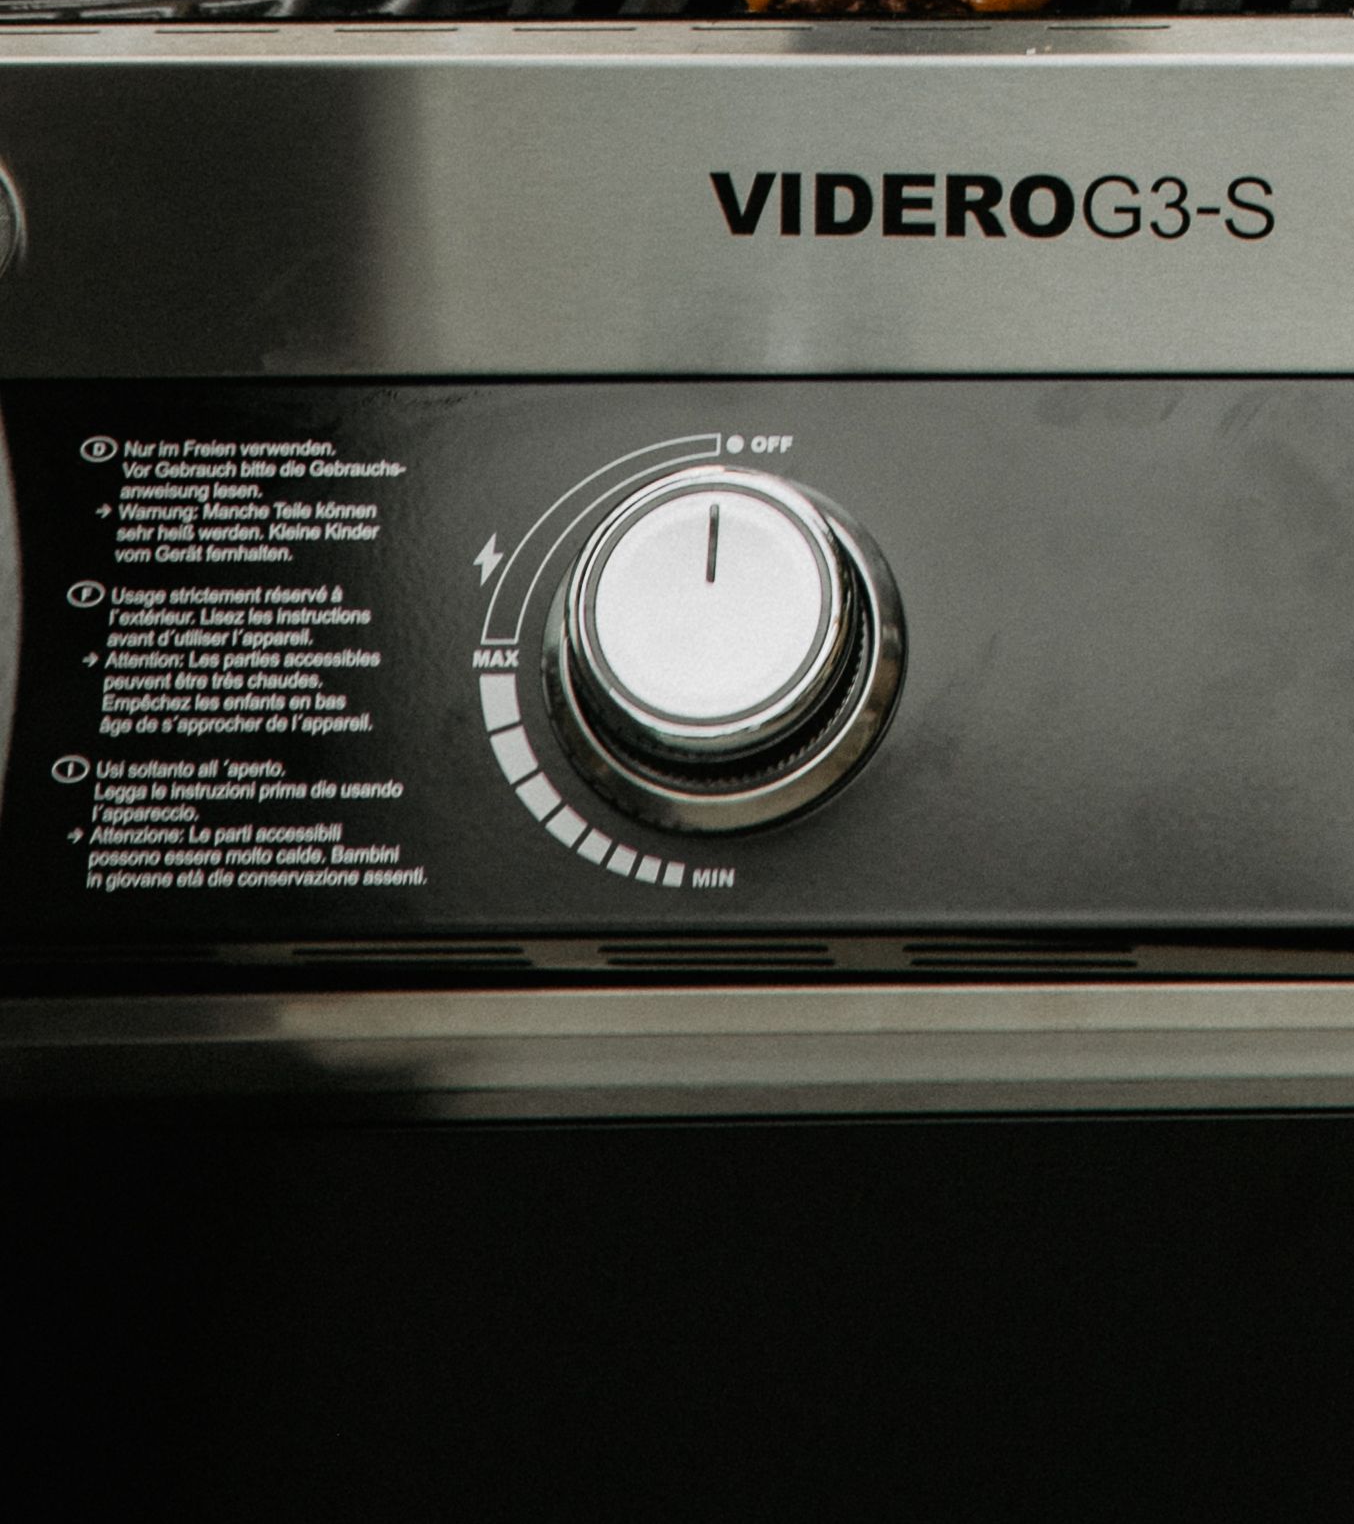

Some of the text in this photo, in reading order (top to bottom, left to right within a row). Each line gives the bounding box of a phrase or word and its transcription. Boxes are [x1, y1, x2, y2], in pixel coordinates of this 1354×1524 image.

[124, 441, 155, 457] Nur
[158, 441, 179, 457] im
[184, 440, 236, 457] Freien
[241, 439, 336, 456] verwenden.
[750, 435, 794, 454] OFF
[123, 462, 151, 478] Vor
[155, 461, 236, 478] Gebrauch
[241, 461, 275, 477] bitte
[309, 459, 406, 477] Gebrauchs-
[120, 482, 263, 502] anweisung lesen.
[203, 502, 269, 519] Manche
[274, 502, 311, 519] Teile
[315, 502, 377, 519] können
[116, 523, 380, 541] sehr heiß werden. Kleine Kinder
[114, 548, 150, 562] vom
[155, 545, 203, 562] Gerät
[112, 587, 166, 608] Usage
[169, 587, 261, 604] strictement
[200, 608, 244, 625] Lisez
[248, 608, 273, 625] les
[277, 606, 371, 624] instructions
[106, 630, 154, 647] avant
[104, 649, 380, 671] Attention: Les parties accessibles
[473, 649, 519, 668] MAX
[103, 673, 171, 693] peuvent
[195, 694, 219, 711] les
[223, 693, 286, 711] enfants
[289, 696, 311, 710] en
[315, 693, 346, 710] bas
[136, 716, 158, 733] de
[266, 714, 288, 732] de
[96, 761, 124, 778] Usi
[128, 761, 195, 778] soltanto
[152, 782, 166, 800] le
[170, 781, 256, 799] instruzioni
[259, 781, 306, 802] prima
[341, 780, 403, 798] usando
[89, 824, 342, 846] Attenzione: Le parti accessibili
[88, 851, 160, 869] possono
[164, 850, 222, 865] essere
[226, 847, 271, 865] molto
[331, 845, 399, 864] Bambini
[86, 871, 102, 888] in
[106, 870, 171, 892] giovane
[238, 868, 359, 887] conservazione
[363, 867, 428, 885] assenti.
[692, 869, 734, 888] MIN
